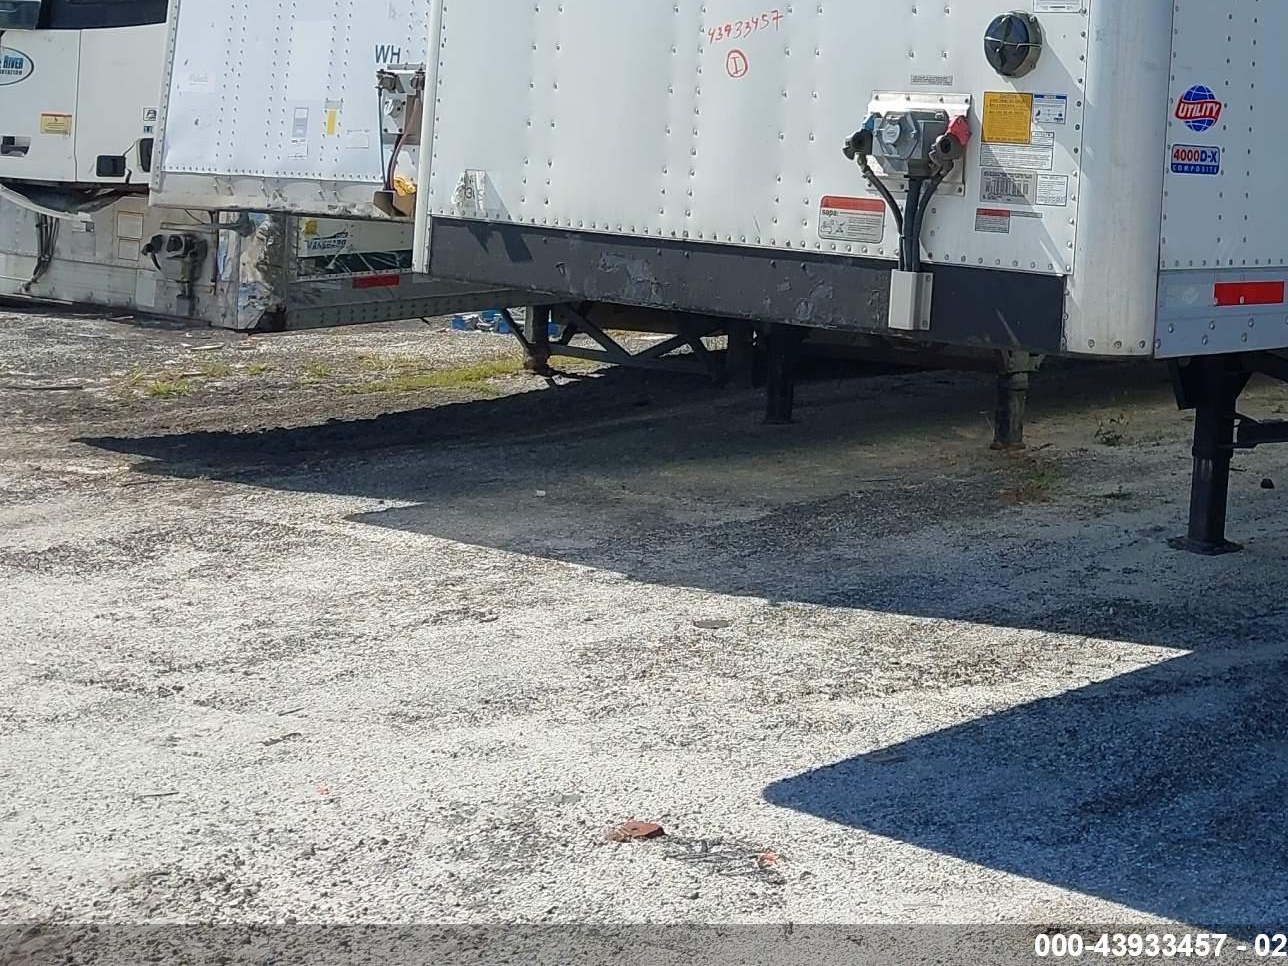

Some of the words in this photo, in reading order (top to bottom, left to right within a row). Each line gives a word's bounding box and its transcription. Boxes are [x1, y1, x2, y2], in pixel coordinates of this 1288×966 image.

[708, 10, 784, 44] 43933457
[375, 44, 401, 64] WH
[1178, 101, 1220, 119] UTILITY
[1173, 149, 1218, 163] 4000D-X
[1172, 164, 1217, 173] COMPOSITE
